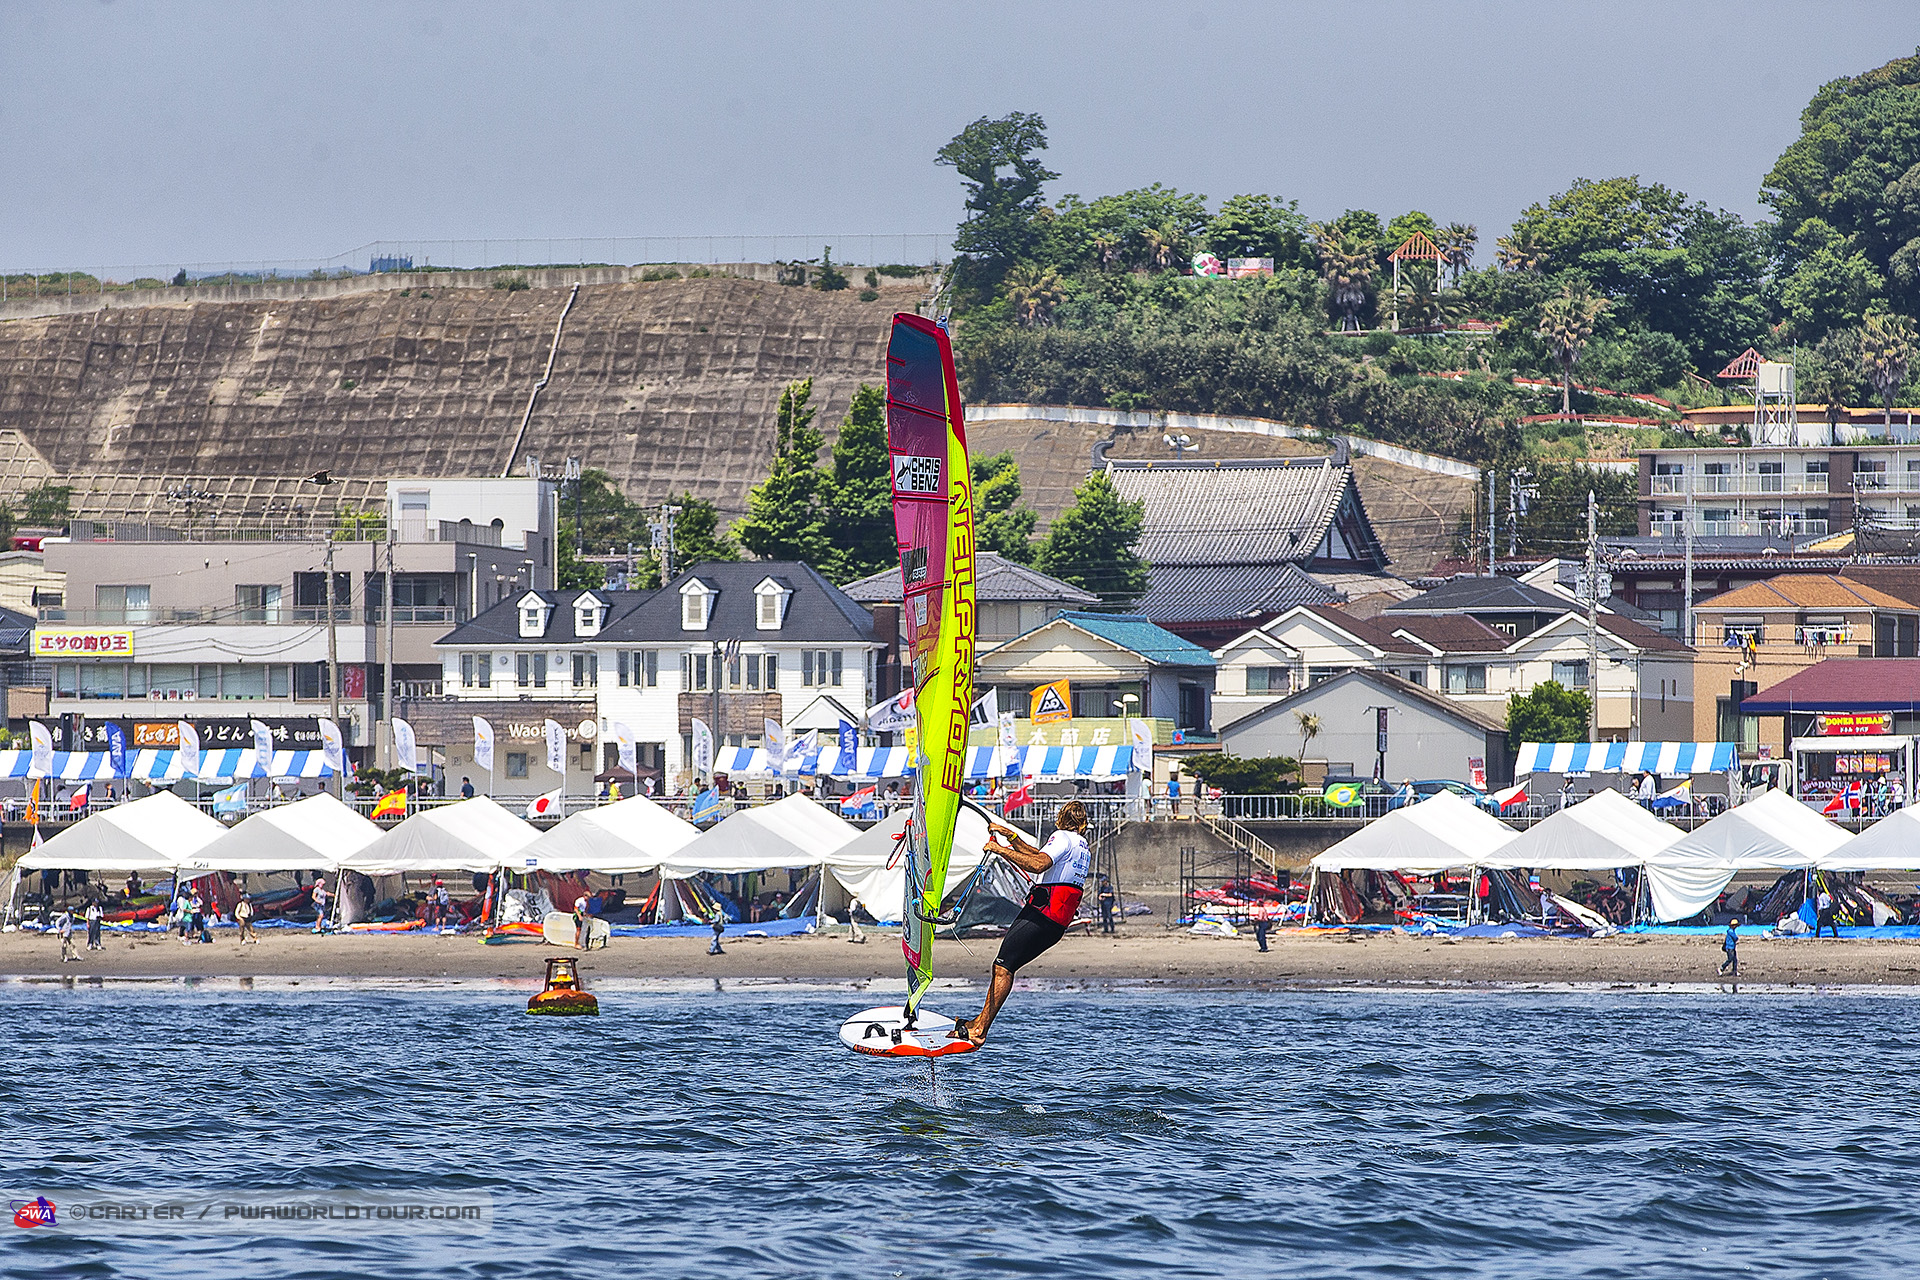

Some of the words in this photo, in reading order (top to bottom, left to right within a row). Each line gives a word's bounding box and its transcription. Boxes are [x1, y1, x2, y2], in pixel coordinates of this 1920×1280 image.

[911, 457, 940, 473] CHRIS
[911, 473, 939, 491] BENZ
[41, 636, 128, 651] エサの釣り王
[941, 481, 973, 794] NEILPRYDE
[998, 727, 1112, 746] 木商店
